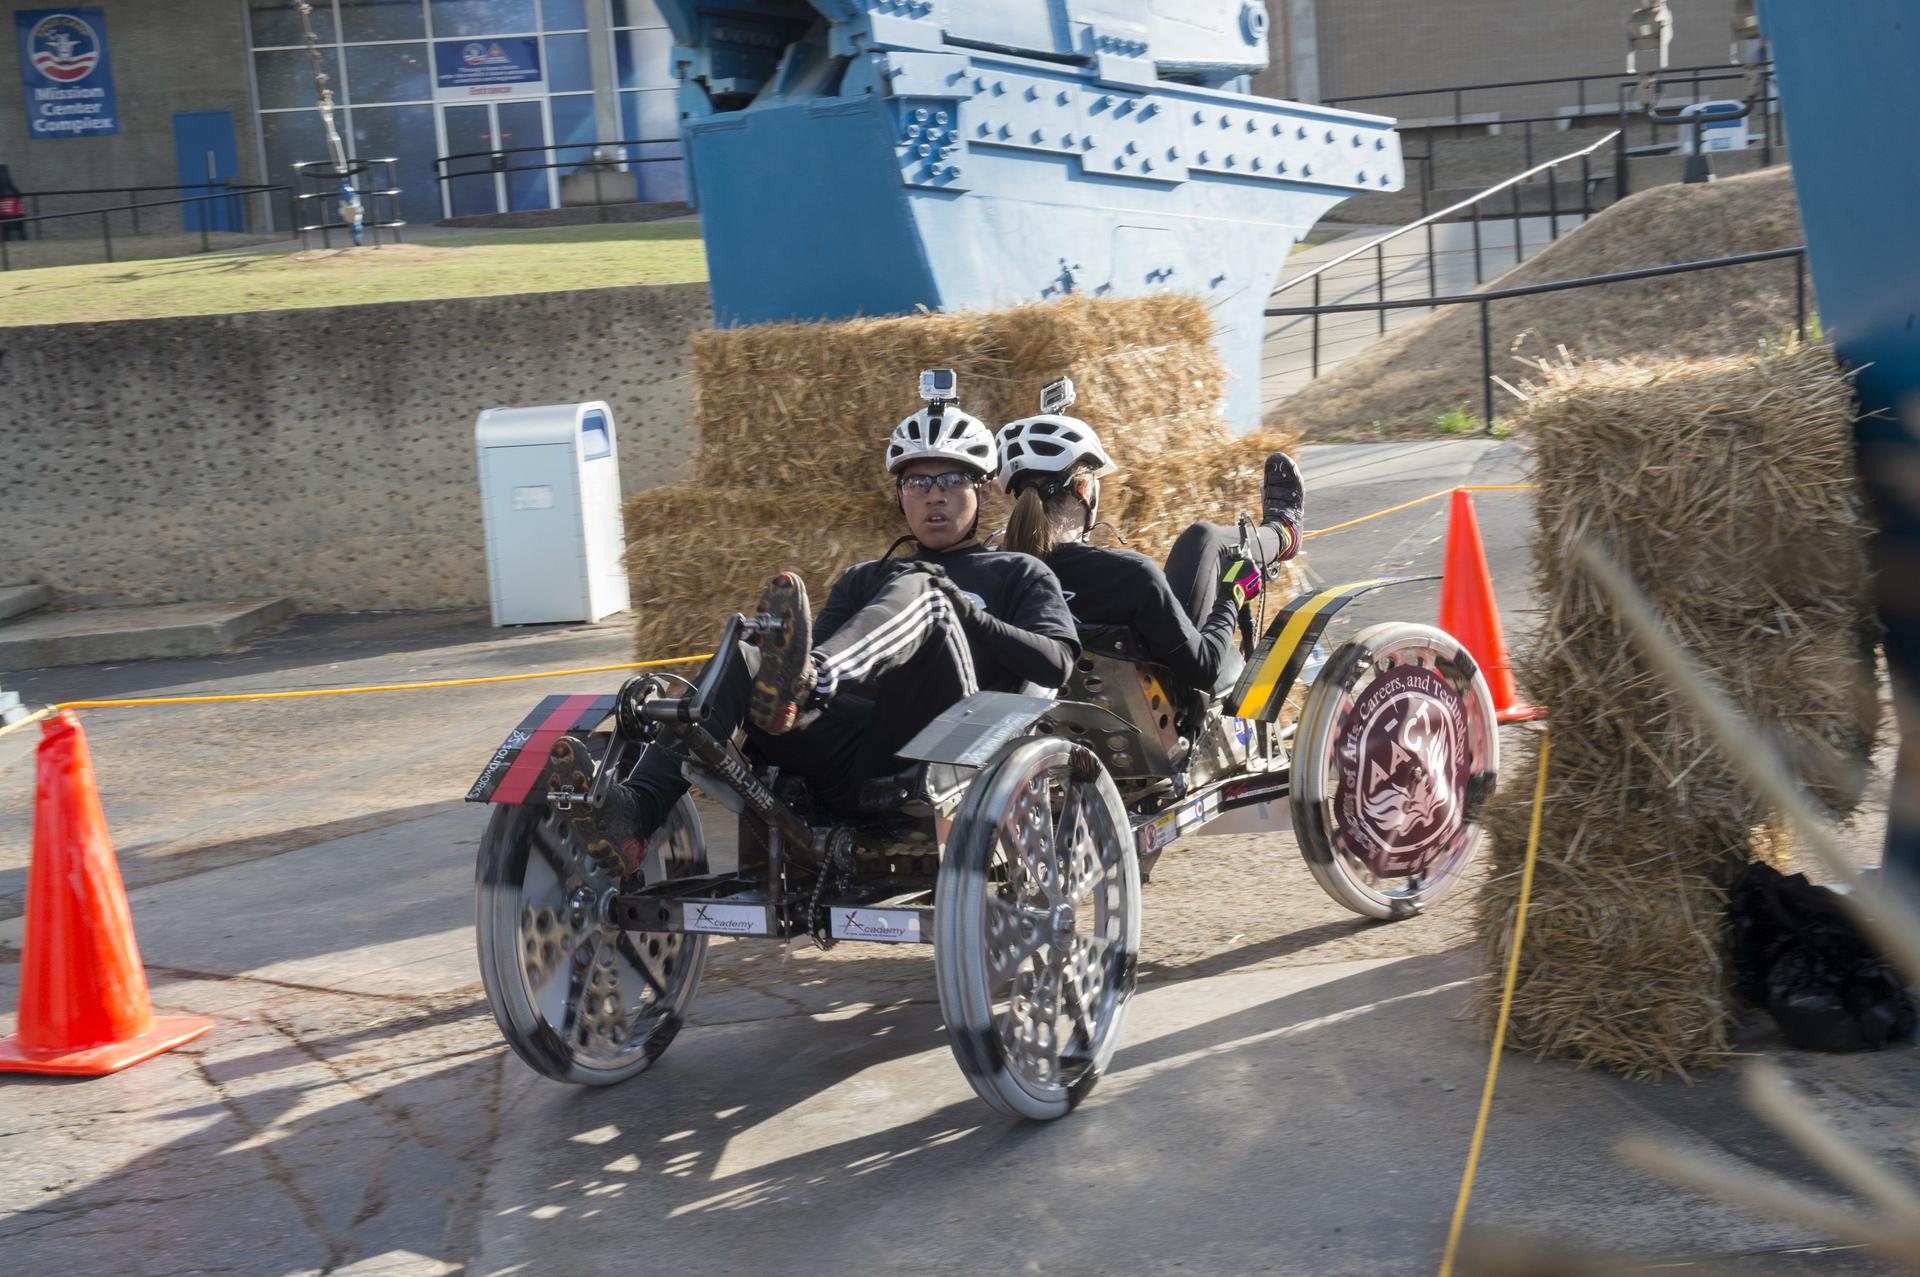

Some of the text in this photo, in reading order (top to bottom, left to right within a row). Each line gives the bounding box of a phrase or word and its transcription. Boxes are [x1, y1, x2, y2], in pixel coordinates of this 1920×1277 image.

[34, 86, 104, 100] Mission
[40, 103, 102, 116] Center
[32, 117, 114, 133] Complex
[1343, 767, 1357, 790] of
[1359, 677, 1406, 720] Careers,
[1407, 675, 1430, 691] and
[720, 754, 774, 810] FALL-LINE
